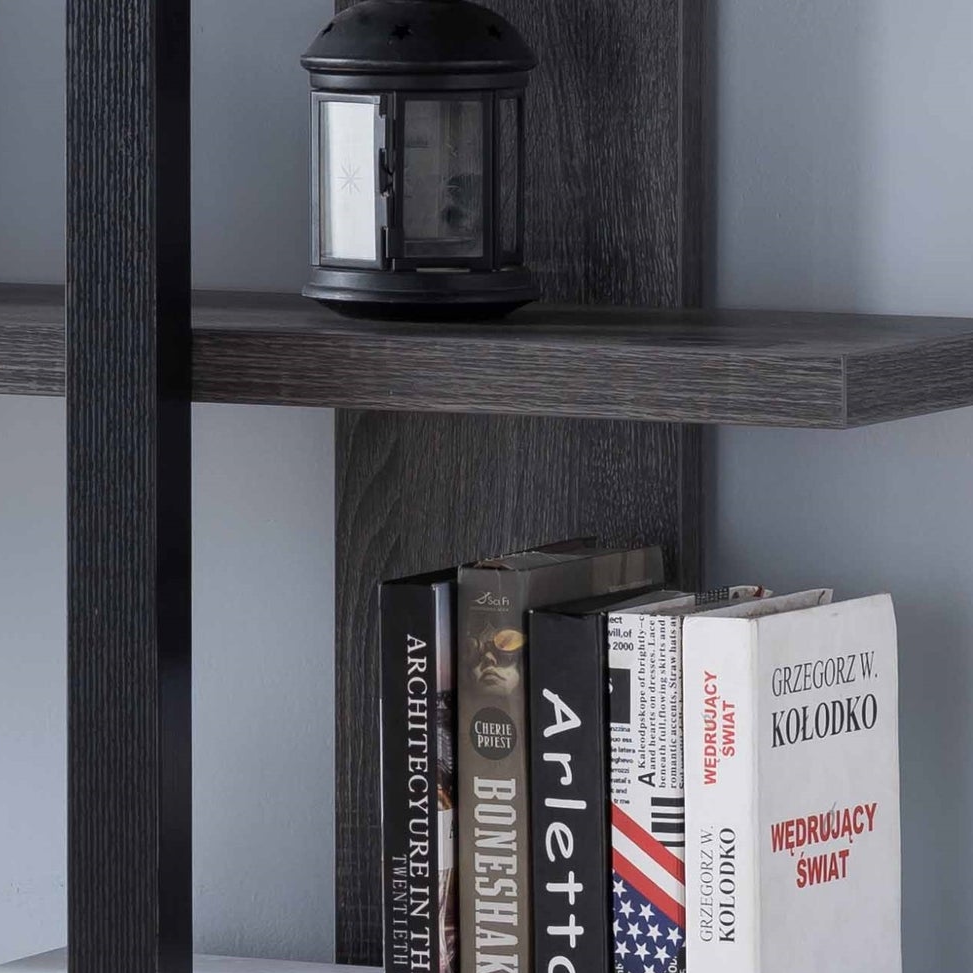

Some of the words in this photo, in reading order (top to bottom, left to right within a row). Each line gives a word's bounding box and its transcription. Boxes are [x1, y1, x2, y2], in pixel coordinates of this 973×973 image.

[648, 620, 656, 646] Lace
[658, 620, 667, 640] and
[669, 629, 677, 653] hats
[658, 643, 667, 675] skirts
[668, 655, 677, 689] Straw
[772, 654, 856, 697] GRZEGORZ
[859, 651, 878, 680] W.
[638, 676, 645, 688] of
[649, 695, 656, 709] on
[474, 720, 513, 736] CHERIE
[648, 711, 656, 747] hearts
[771, 693, 878, 748] KOŁODKO
[406, 634, 429, 877] ARCHITECYURE
[477, 734, 512, 749] PRIEST
[648, 750, 656, 770] and
[658, 746, 667, 789] beneath
[669, 738, 677, 789] romantic
[638, 772, 655, 787] A
[700, 825, 714, 844] W.
[771, 803, 877, 857] WĘDRUJĄCY
[796, 850, 850, 889] ŚWIAT
[391, 854, 408, 965] TWENTIETH
[409, 885, 430, 919] IN
[700, 849, 714, 942] GRZEGORZ
